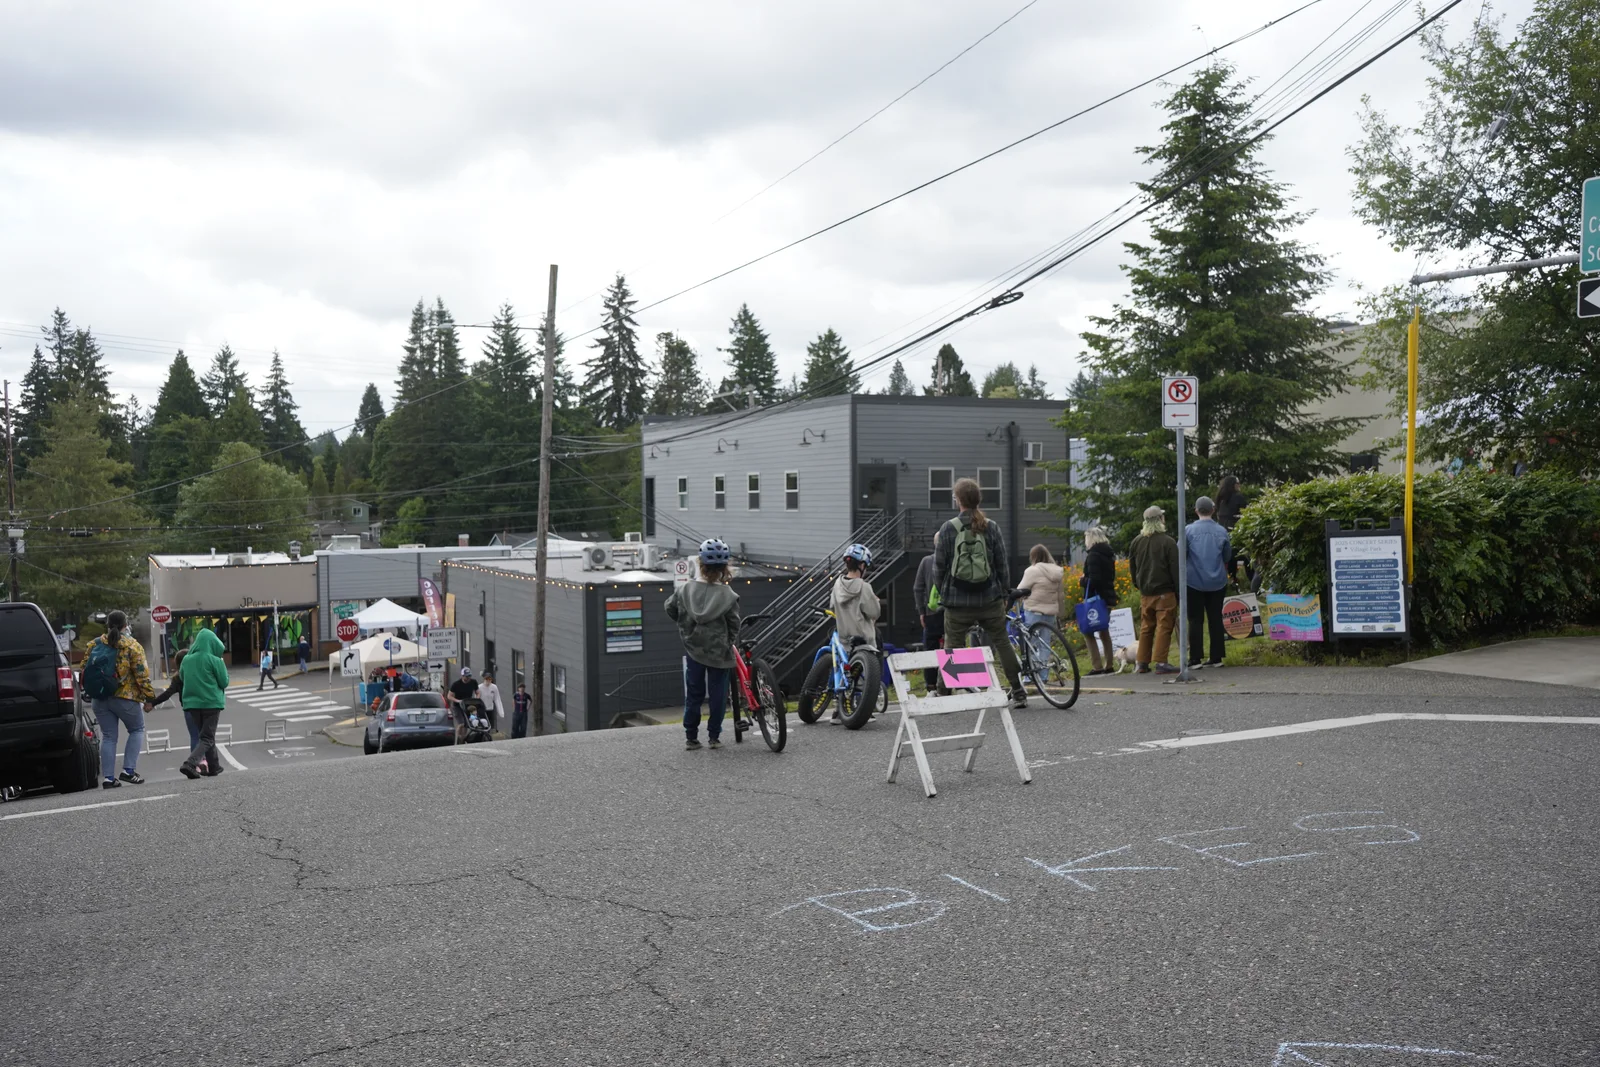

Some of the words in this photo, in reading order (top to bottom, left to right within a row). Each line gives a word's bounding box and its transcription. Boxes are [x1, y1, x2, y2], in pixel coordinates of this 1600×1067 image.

[240, 597, 253, 608] JP
[1240, 606, 1257, 615] SALE
[1268, 605, 1293, 615] Family
[1294, 602, 1319, 615] Picnics
[1230, 616, 1242, 624] DAY
[337, 625, 358, 636] STOP
[770, 809, 1421, 933] BIKES
